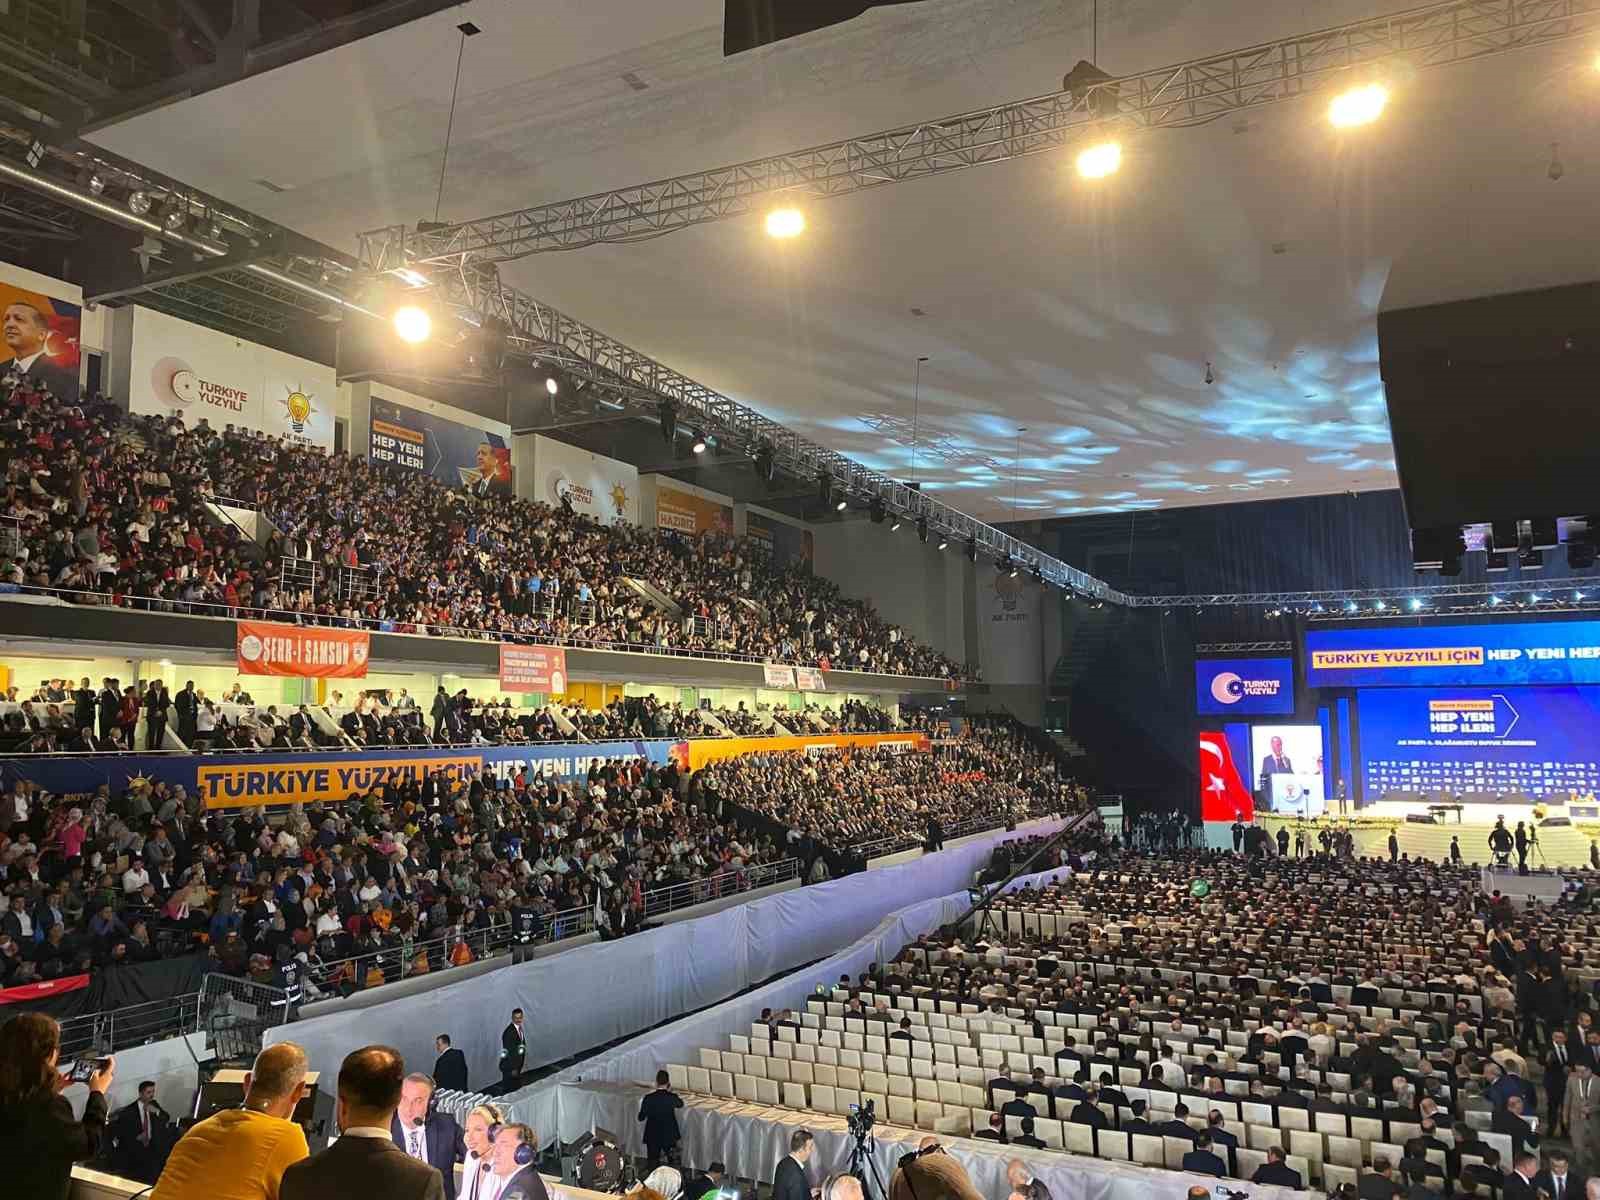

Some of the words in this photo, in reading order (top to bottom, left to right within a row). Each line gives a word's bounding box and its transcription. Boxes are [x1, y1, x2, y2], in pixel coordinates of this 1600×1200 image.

[372, 434, 396, 449] HEP
[372, 447, 395, 461] HEP
[304, 639, 350, 665] SAMSUN
[1316, 653, 1379, 664] TÜRKİYE
[1487, 649, 1521, 661] HEP
[1568, 646, 1600, 659] HEP
[1430, 712, 1458, 722] HEP
[1430, 723, 1458, 733] HEP
[205, 769, 329, 797] TÜRKİYE
